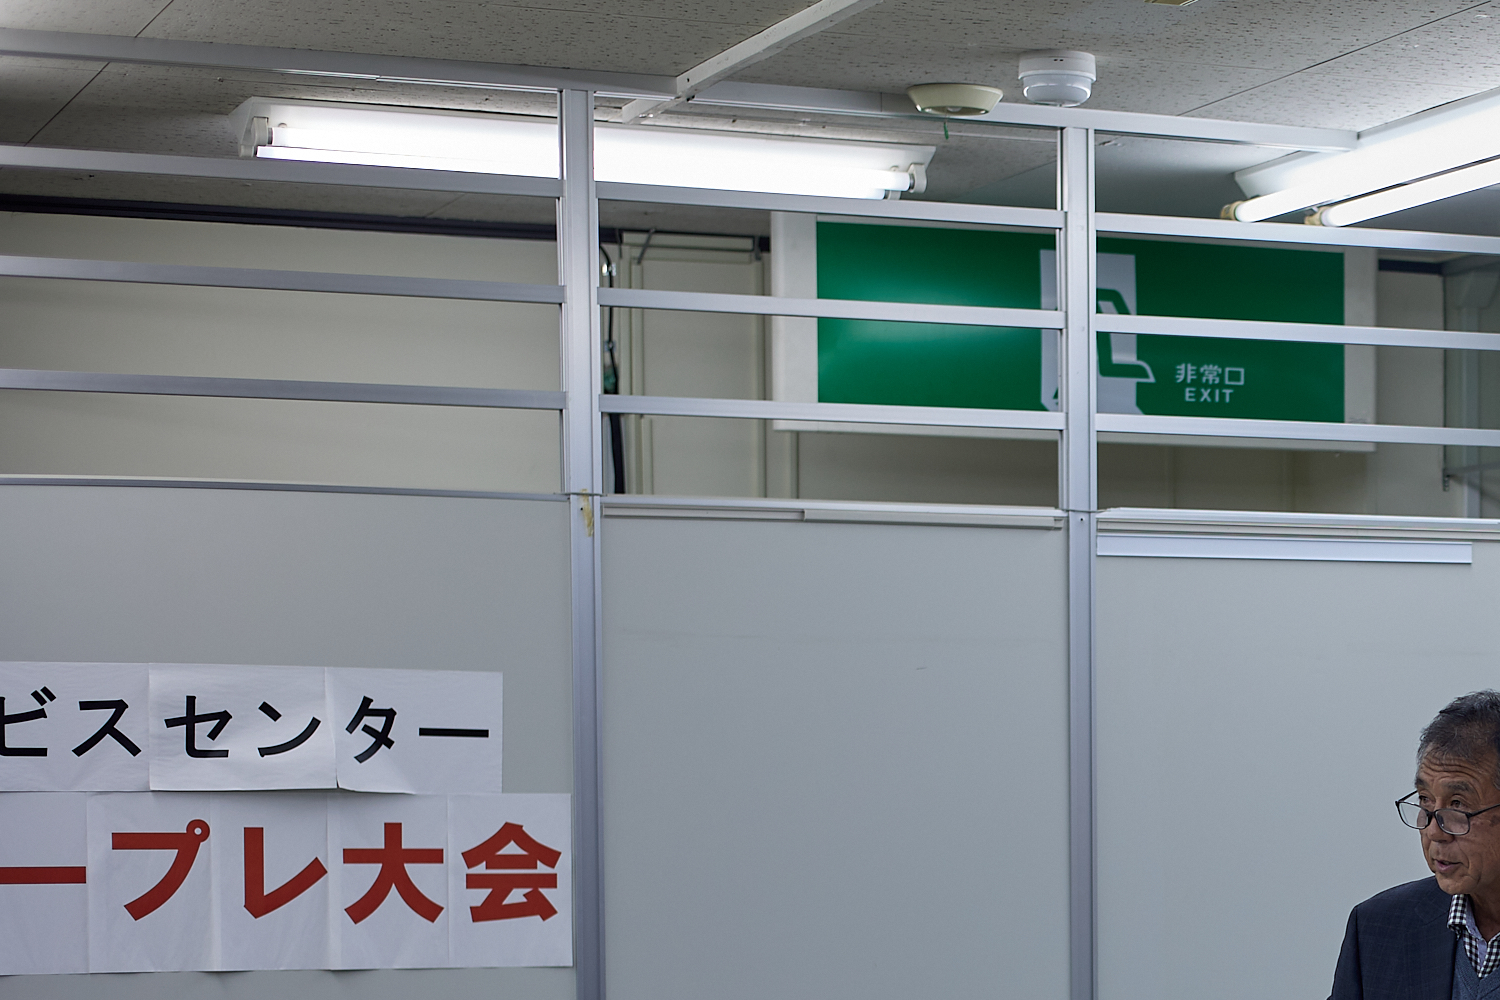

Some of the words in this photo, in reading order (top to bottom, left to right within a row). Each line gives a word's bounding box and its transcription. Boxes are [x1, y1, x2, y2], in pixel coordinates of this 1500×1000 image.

[1175, 363, 1244, 385] 非常口
[1185, 387, 1234, 403] EXIT
[0, 686, 489, 763] ビスセンター
